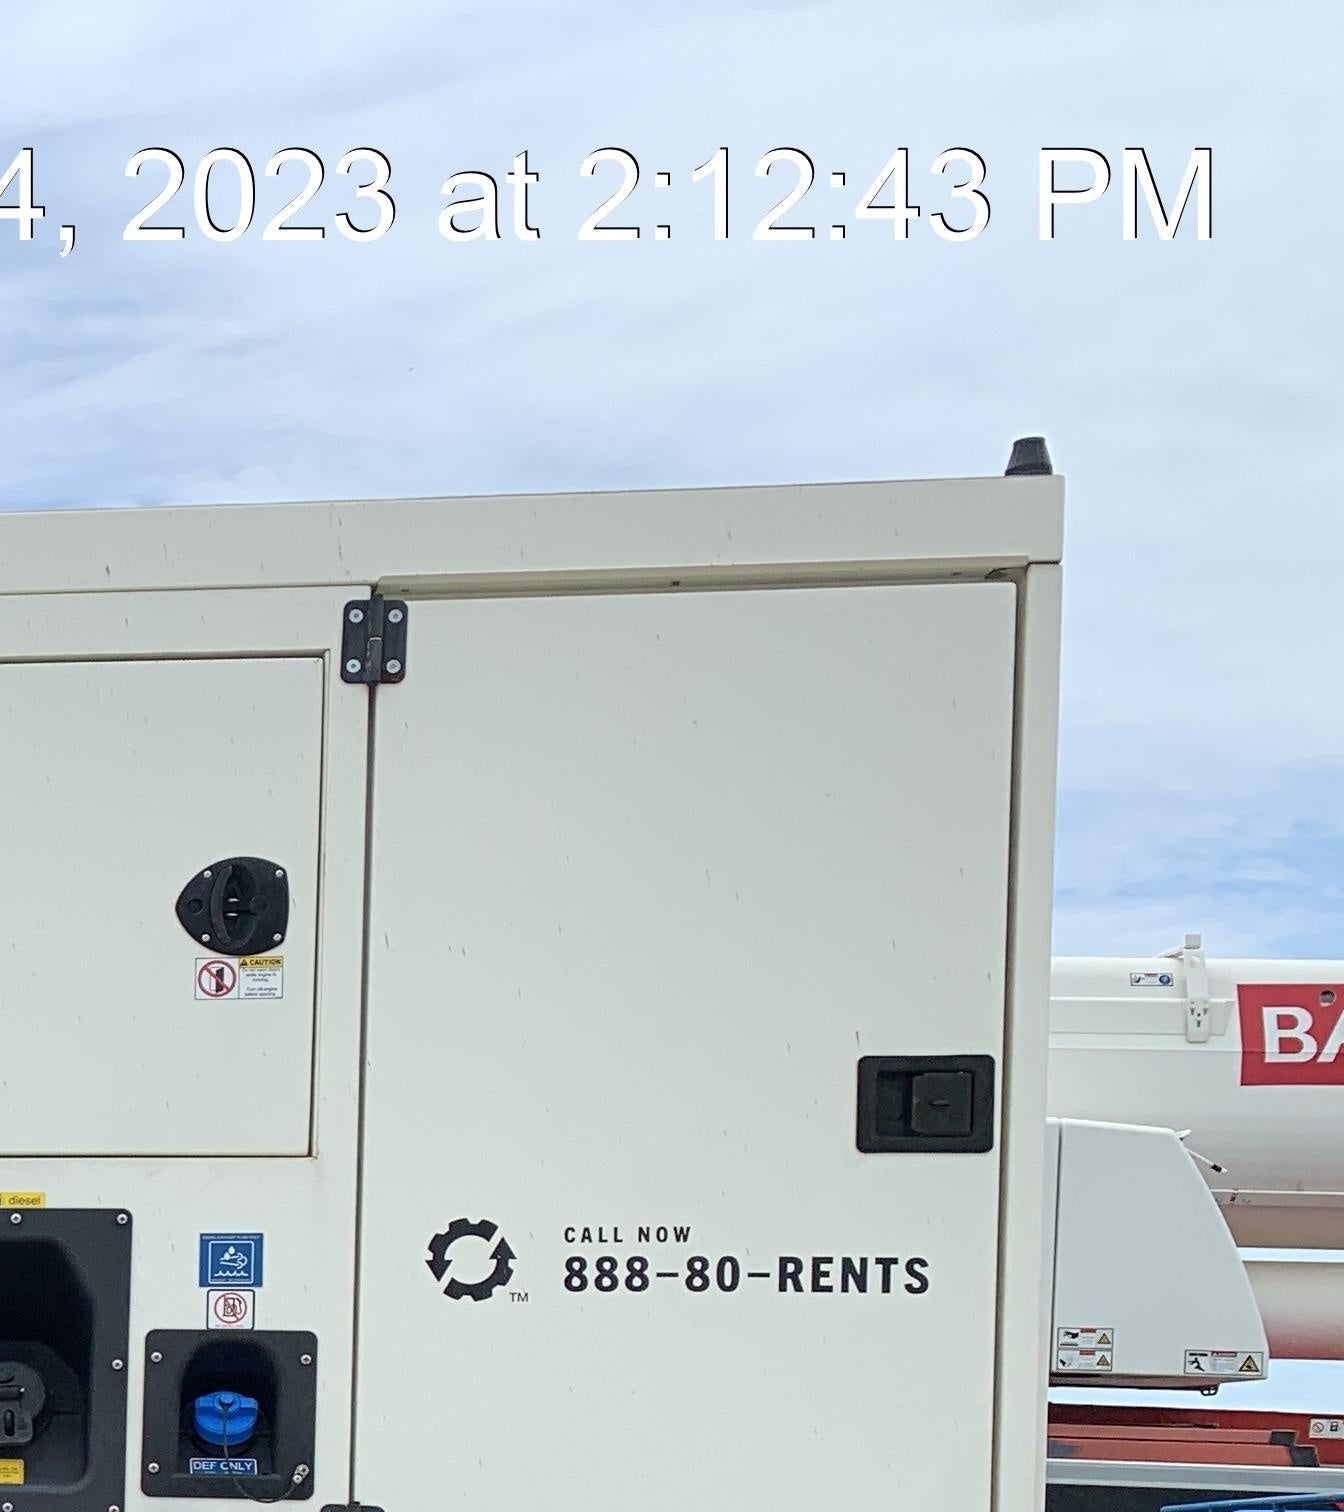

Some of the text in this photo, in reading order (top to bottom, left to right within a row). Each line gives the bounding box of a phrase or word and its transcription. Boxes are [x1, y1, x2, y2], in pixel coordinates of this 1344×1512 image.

[9, 1196, 41, 1205] diesel
[564, 1226, 692, 1244] CALL NOW
[564, 1255, 930, 1294] 888-80-RENTS
[193, 1461, 252, 1471] DEF ONLY
